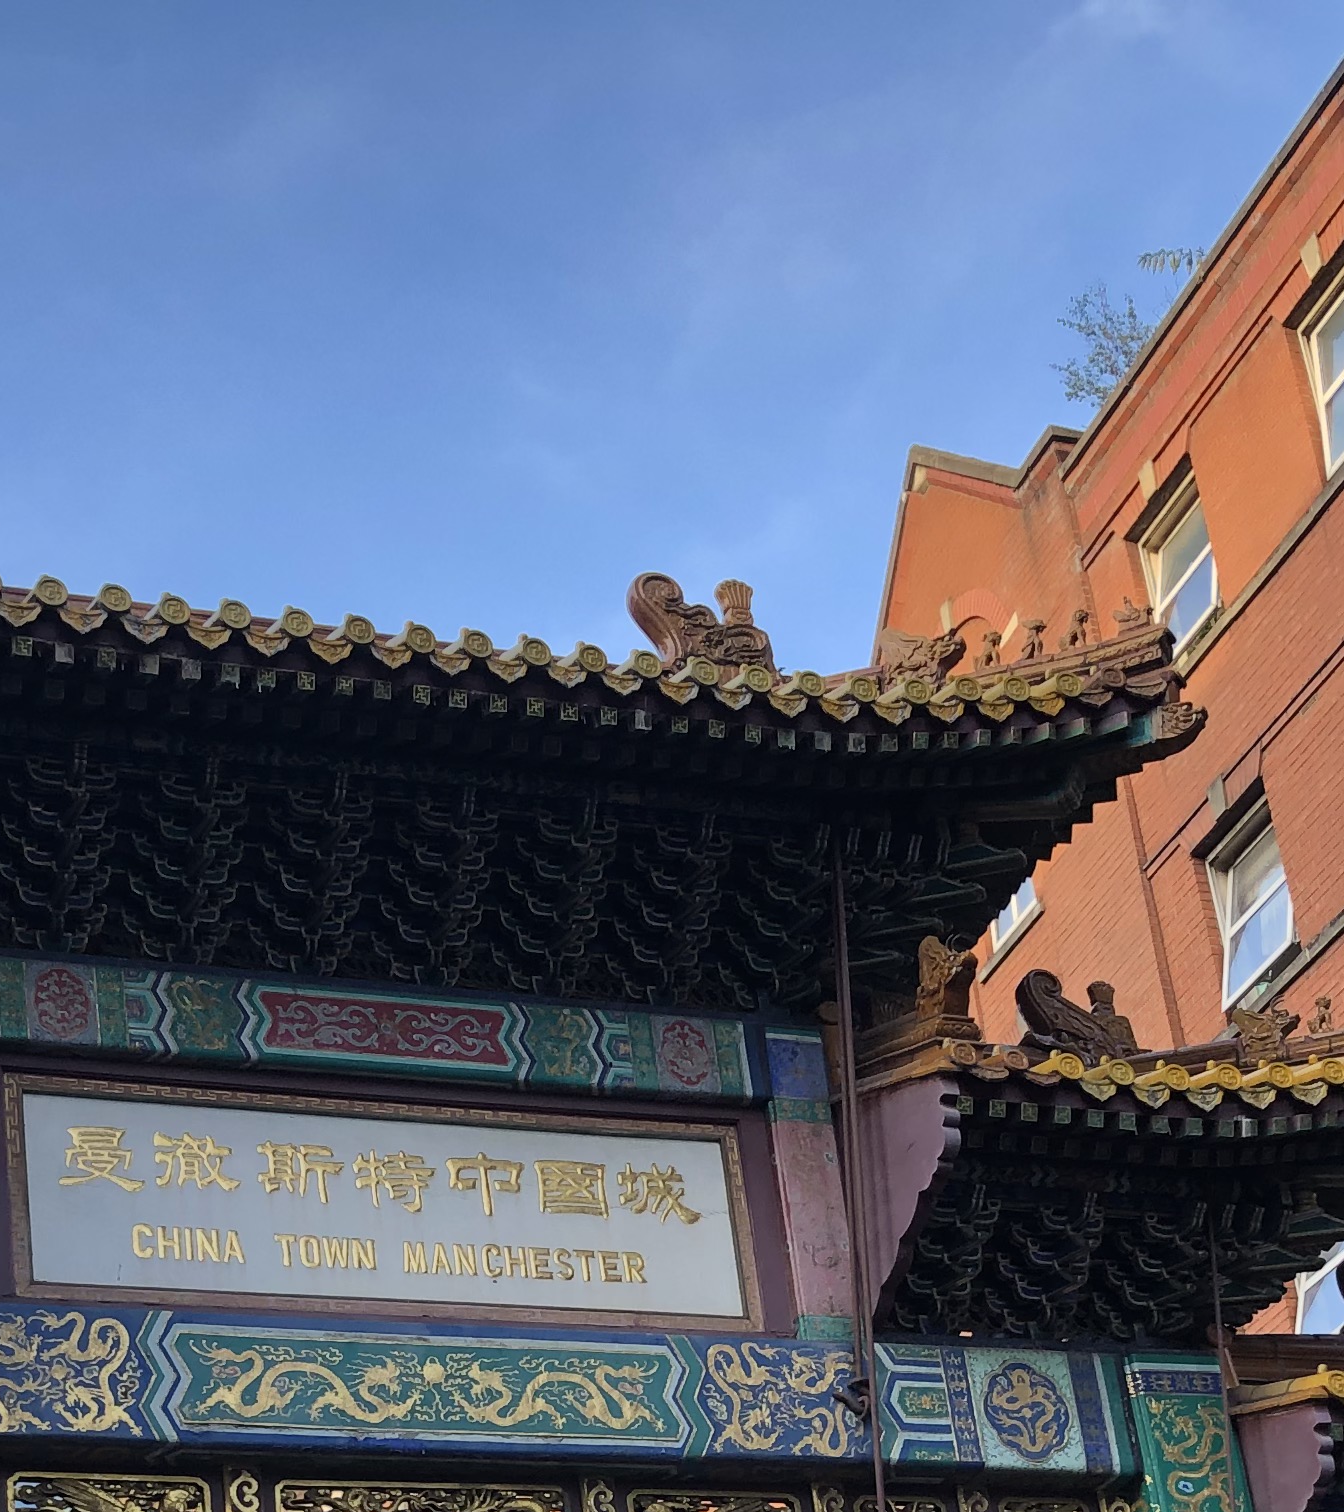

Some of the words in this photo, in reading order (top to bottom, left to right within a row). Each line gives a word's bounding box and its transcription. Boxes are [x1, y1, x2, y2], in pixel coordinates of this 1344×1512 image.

[131, 1222, 246, 1265] CHINA
[273, 1233, 377, 1271] TOWN
[402, 1242, 647, 1284] MANCHESTER
